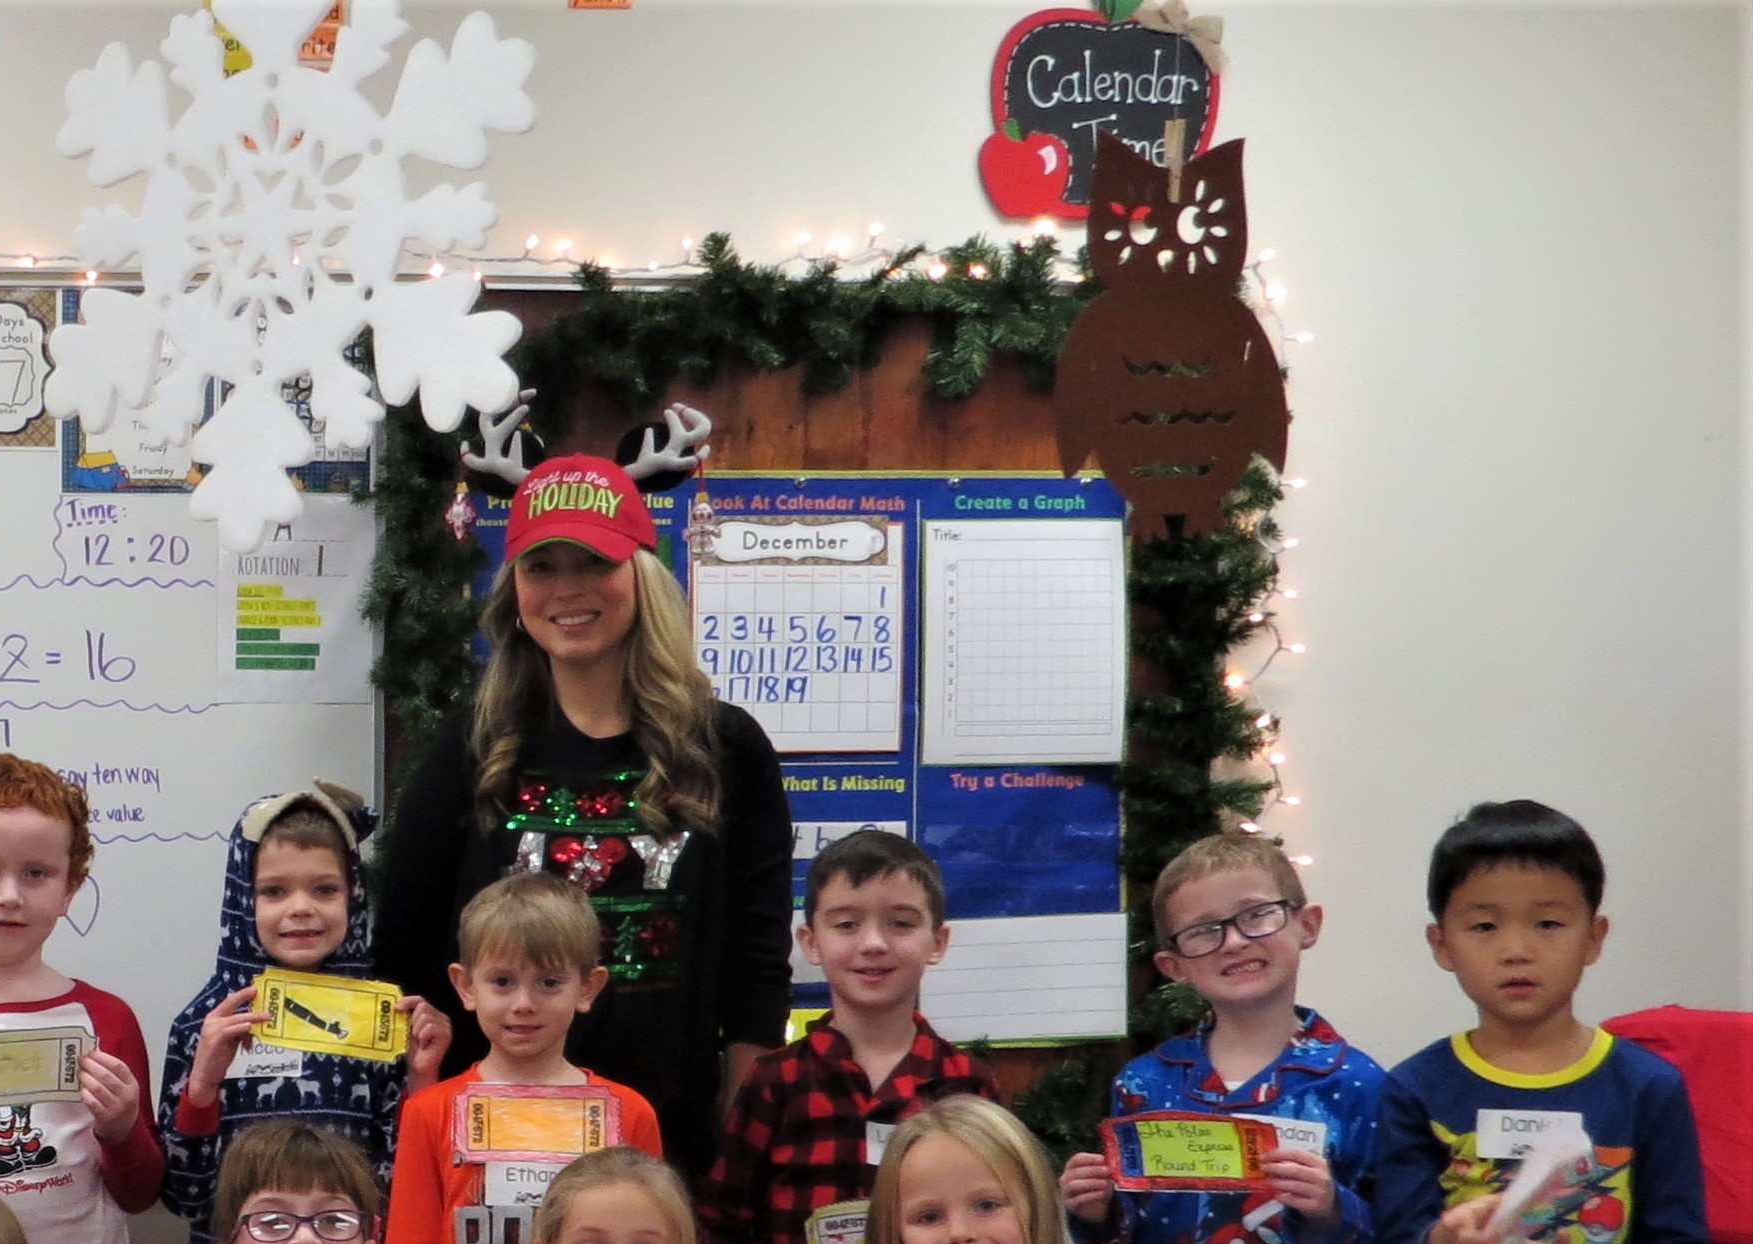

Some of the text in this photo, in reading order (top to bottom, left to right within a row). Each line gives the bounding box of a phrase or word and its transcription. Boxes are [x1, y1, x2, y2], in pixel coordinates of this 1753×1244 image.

[1026, 50, 1198, 109] Calendar
[0, 358, 27, 403] 7
[131, 465, 175, 478] Saturday
[562, 470, 610, 487] up the
[528, 482, 624, 519] HOLIDAY
[750, 495, 906, 512] At Calendar Math
[955, 495, 1087, 513] Create a Graph
[742, 531, 849, 550] December
[932, 528, 964, 542] Title:
[237, 554, 300, 577] ROTATION
[879, 586, 887, 609] 1
[703, 615, 891, 643] 2 3 4 5 6 7 8
[86, 630, 137, 684] 16
[701, 645, 893, 675] 9 10 11 12 13 14 15
[728, 676, 808, 703] 17 18 19
[92, 763, 161, 793] ten way
[822, 775, 906, 794] Is Missing
[951, 772, 1085, 792] Try a Challenge
[106, 802, 145, 823] value
